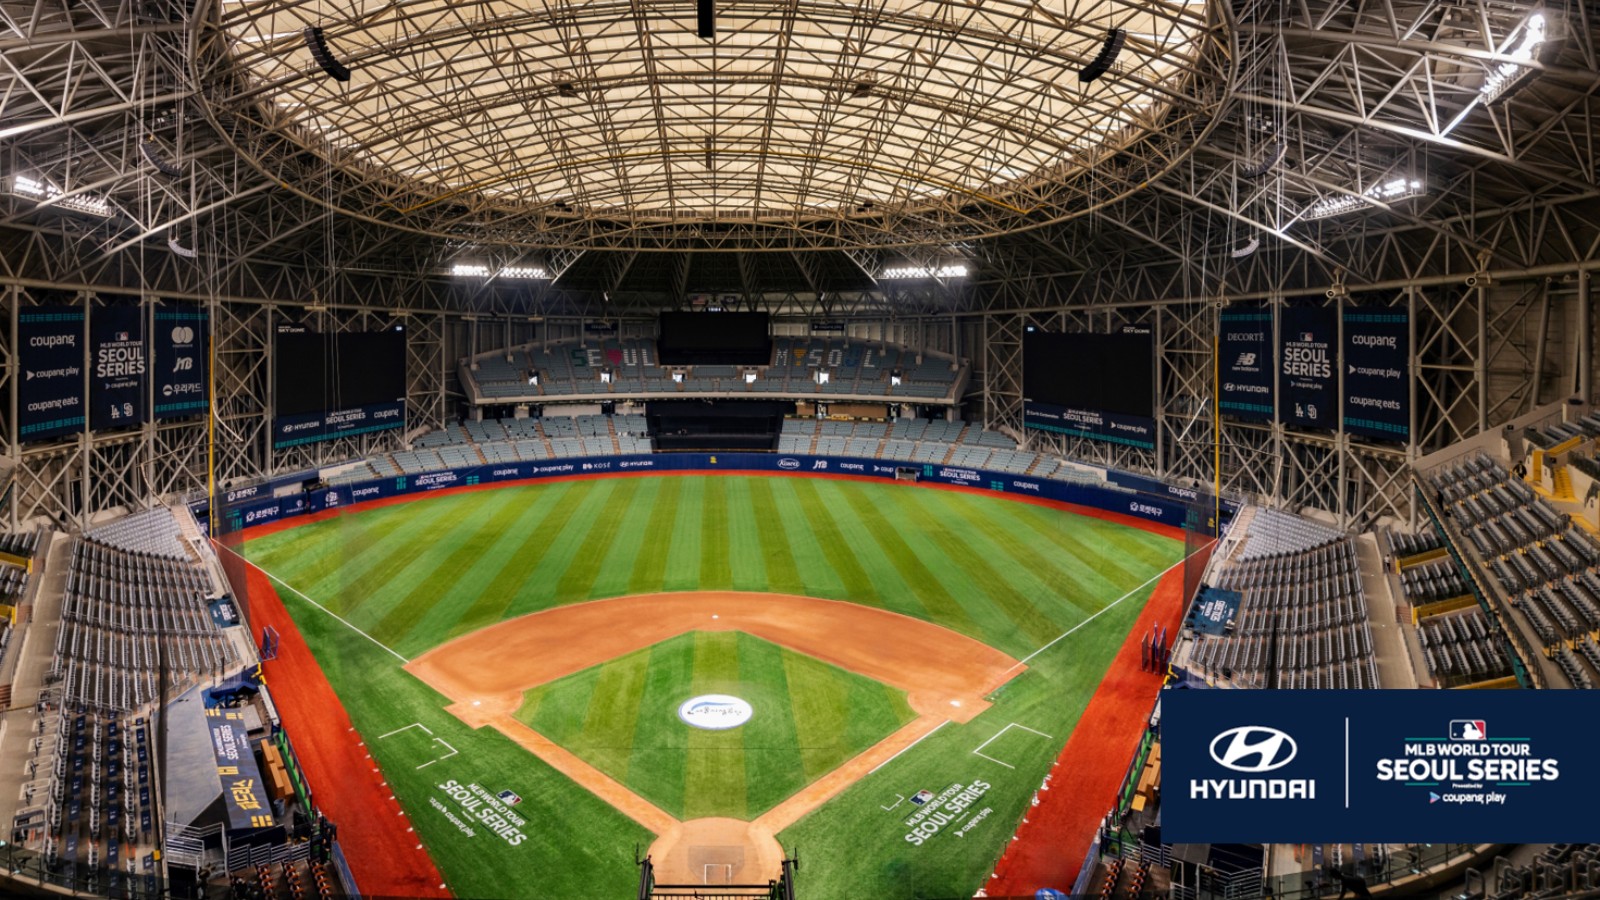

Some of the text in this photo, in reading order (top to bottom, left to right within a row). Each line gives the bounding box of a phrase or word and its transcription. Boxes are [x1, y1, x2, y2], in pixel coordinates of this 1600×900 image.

[30, 334, 75, 349] coupang
[1227, 332, 1264, 342] DECORTÉ
[1352, 334, 1396, 349] coupang
[98, 347, 144, 363] SEOUL
[1284, 347, 1330, 363] SEOUL
[36, 366, 79, 379] coupang play
[97, 360, 145, 378] SERIES
[172, 357, 193, 373] JTB
[1283, 361, 1331, 378] SERIES
[1357, 366, 1401, 379] coupang play
[173, 383, 202, 395] 우리카드
[1236, 384, 1269, 394] HYUNDAI
[28, 396, 79, 411] coupang eats
[1350, 395, 1401, 410] coupang eats
[374, 409, 399, 419] coupang
[493, 468, 518, 476] coupang
[812, 460, 828, 469] JTB
[352, 486, 379, 496] coupang
[1013, 480, 1039, 491] coupang
[1168, 486, 1197, 500] coupang
[481, 792, 507, 813] WORLD
[503, 806, 526, 827] TOUR
[905, 783, 964, 827] MLB WORLD TOUR
[438, 779, 483, 813] SEOUL
[475, 808, 528, 847] SERIES
[904, 780, 991, 846] SEOUL SERIES
